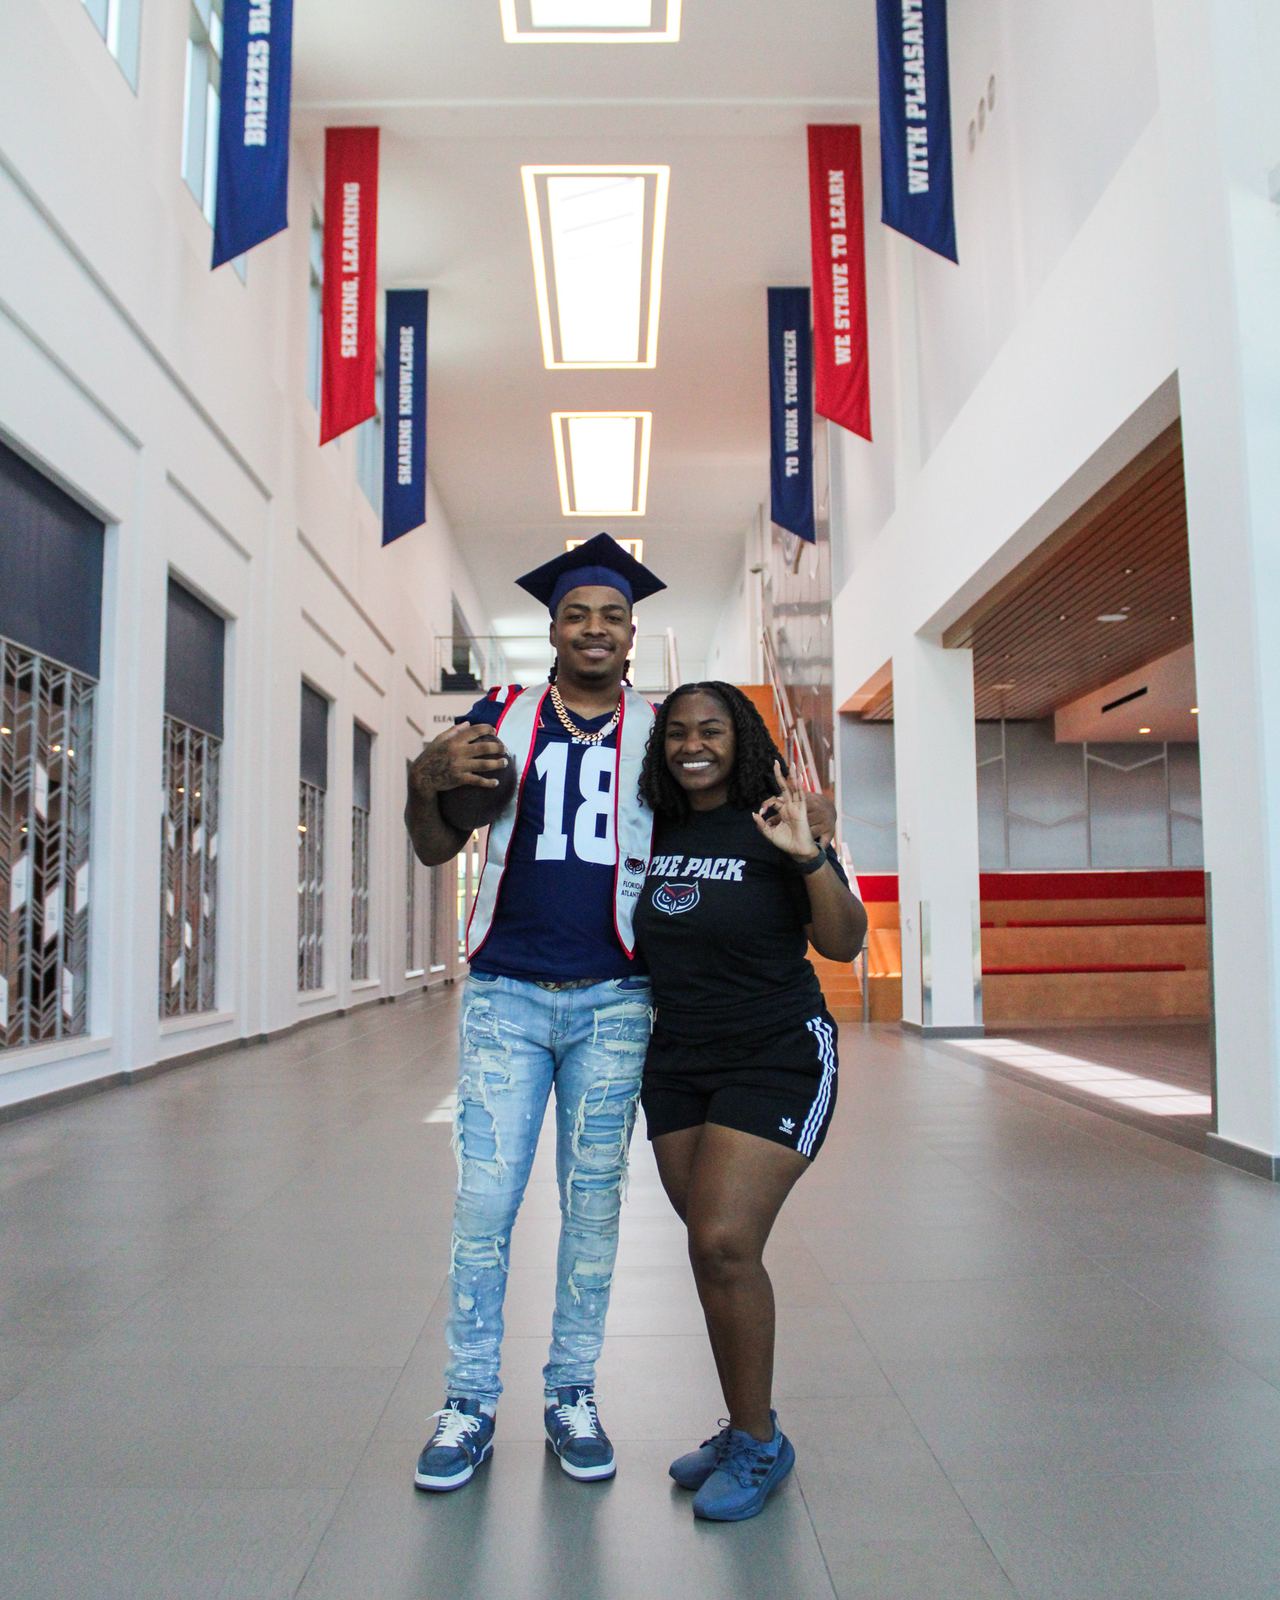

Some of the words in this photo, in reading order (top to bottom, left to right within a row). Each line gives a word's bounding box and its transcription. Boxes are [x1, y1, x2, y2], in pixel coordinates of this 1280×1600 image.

[244, 39, 270, 146] BREEZES
[906, 126, 929, 195] WITH
[342, 182, 360, 273] LEARNING
[828, 170, 846, 229] LEARN
[831, 234, 848, 259] TO
[341, 276, 360, 358] SEEKING,
[832, 263, 850, 330] STRIVE
[399, 325, 415, 415] KNOWLEDGE
[783, 329, 798, 404] TOGETHER
[834, 334, 851, 366] WE
[398, 419, 413, 485] SHARING
[785, 408, 799, 452] WORK
[785, 456, 799, 477] TO
[534, 741, 618, 866] 18
[621, 889, 640, 898] ATLANT
[647, 855, 684, 877] THE
[681, 857, 746, 881] PACK
